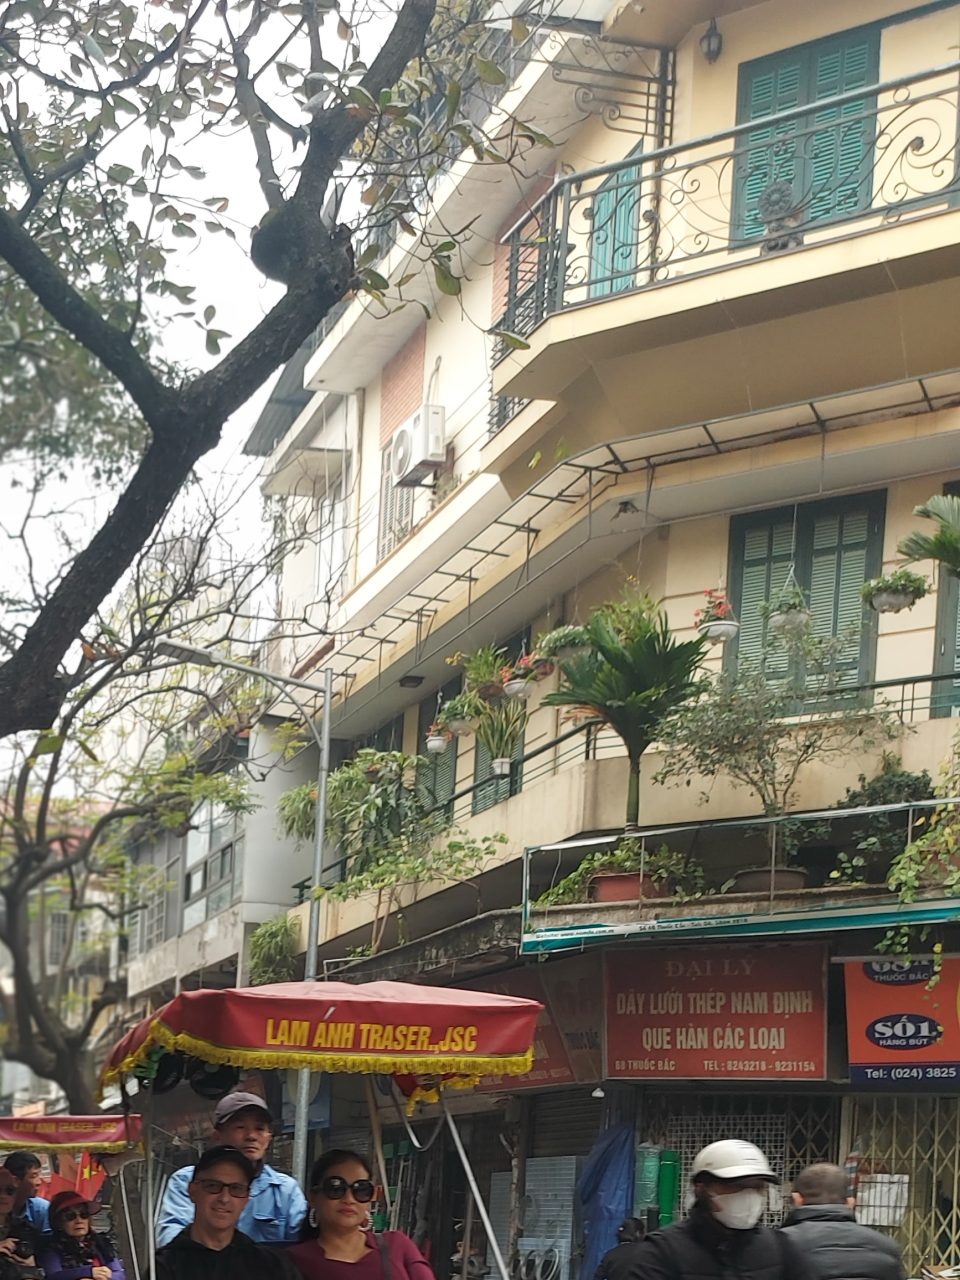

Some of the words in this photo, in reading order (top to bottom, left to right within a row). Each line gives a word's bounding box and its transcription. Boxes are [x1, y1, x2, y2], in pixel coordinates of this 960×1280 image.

[665, 960, 712, 981] ĐẠI
[723, 955, 757, 976] LÝ
[616, 988, 646, 1015] DÂY
[688, 988, 726, 1015] THÉP
[731, 991, 769, 1014] NAM
[772, 991, 813, 1019] ĐỊNH
[266, 1019, 311, 1047] LAM
[642, 1027, 671, 1052] QUE
[677, 1023, 708, 1049] HÀN
[713, 1022, 744, 1050] CÁC
[749, 1027, 785, 1055] LOẠI
[865, 1068, 888, 1079] Tel:
[891, 1068, 923, 1080] (024)
[925, 1067, 957, 1078] 3825
